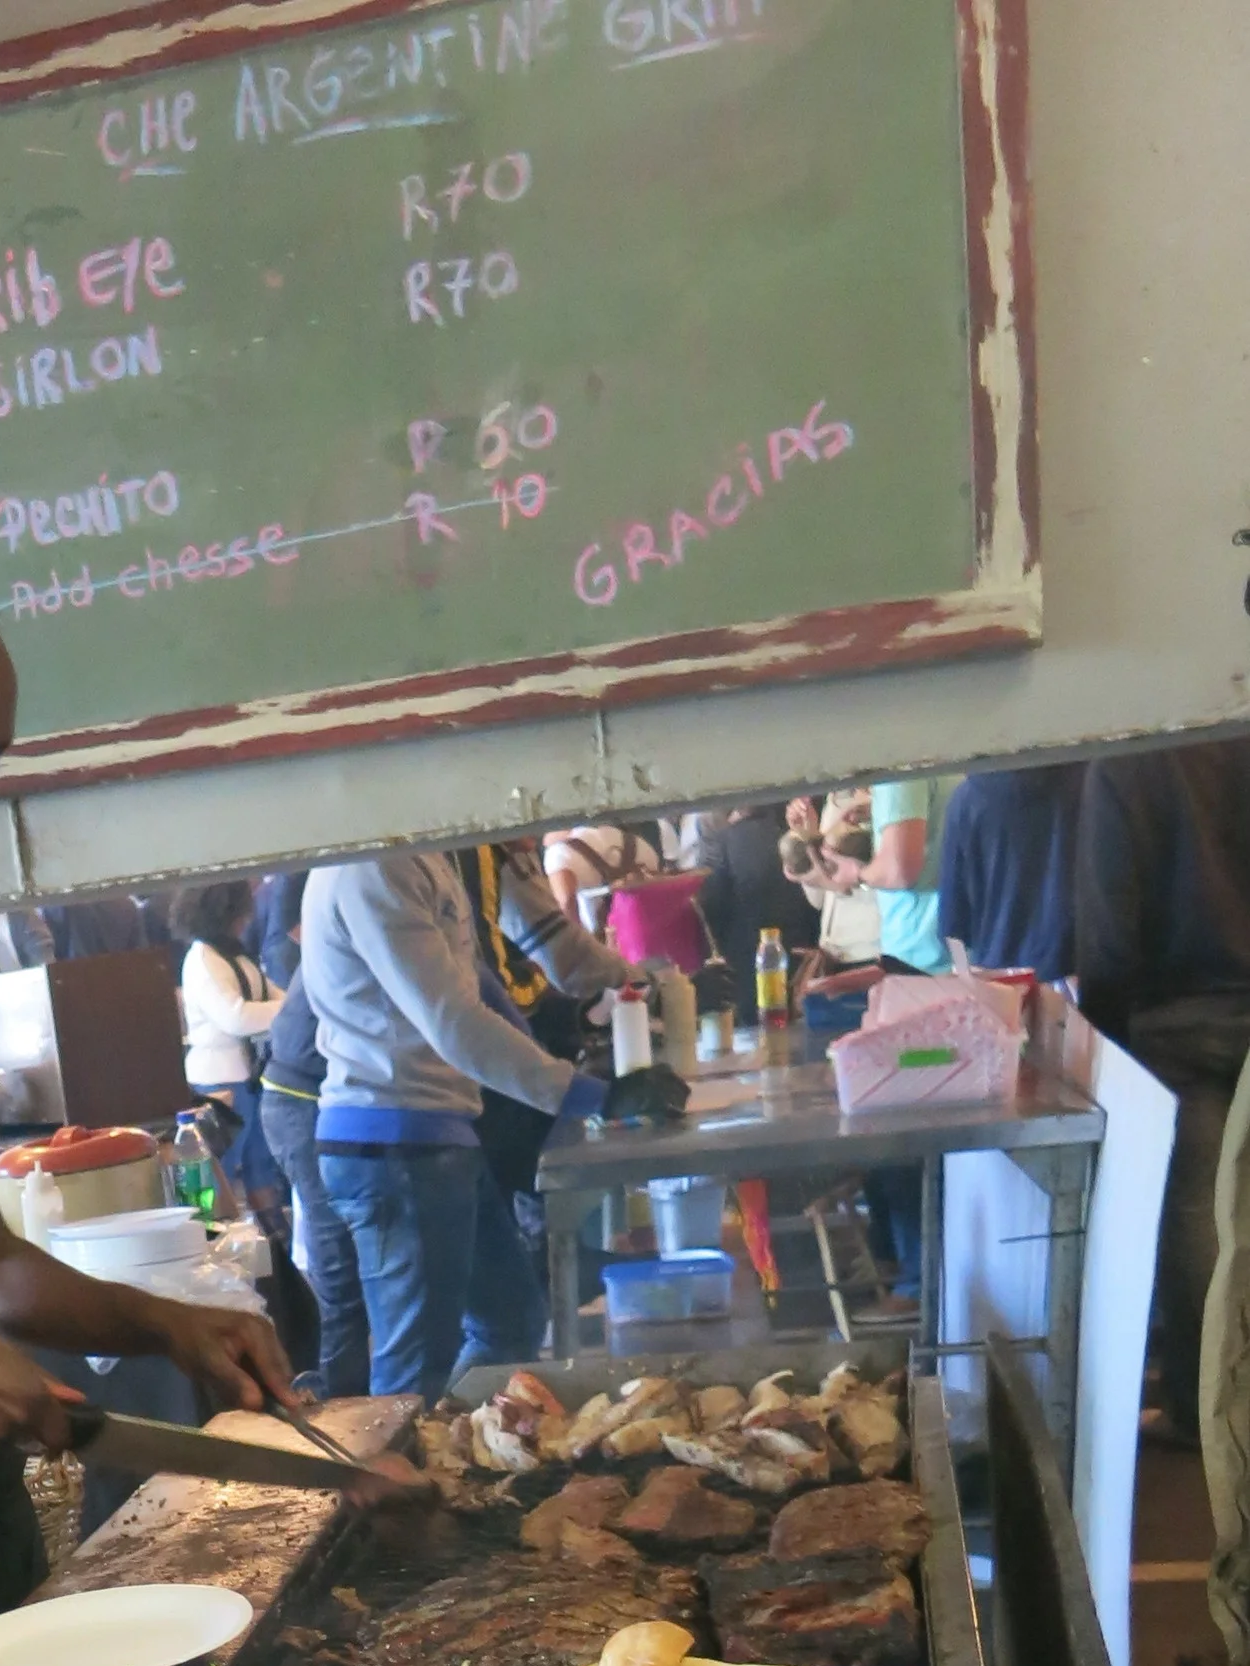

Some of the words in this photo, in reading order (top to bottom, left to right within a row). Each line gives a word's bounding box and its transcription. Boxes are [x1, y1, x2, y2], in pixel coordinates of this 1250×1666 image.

[400, 151, 532, 241] R70
[405, 252, 520, 326] R70
[404, 491, 460, 546] R
